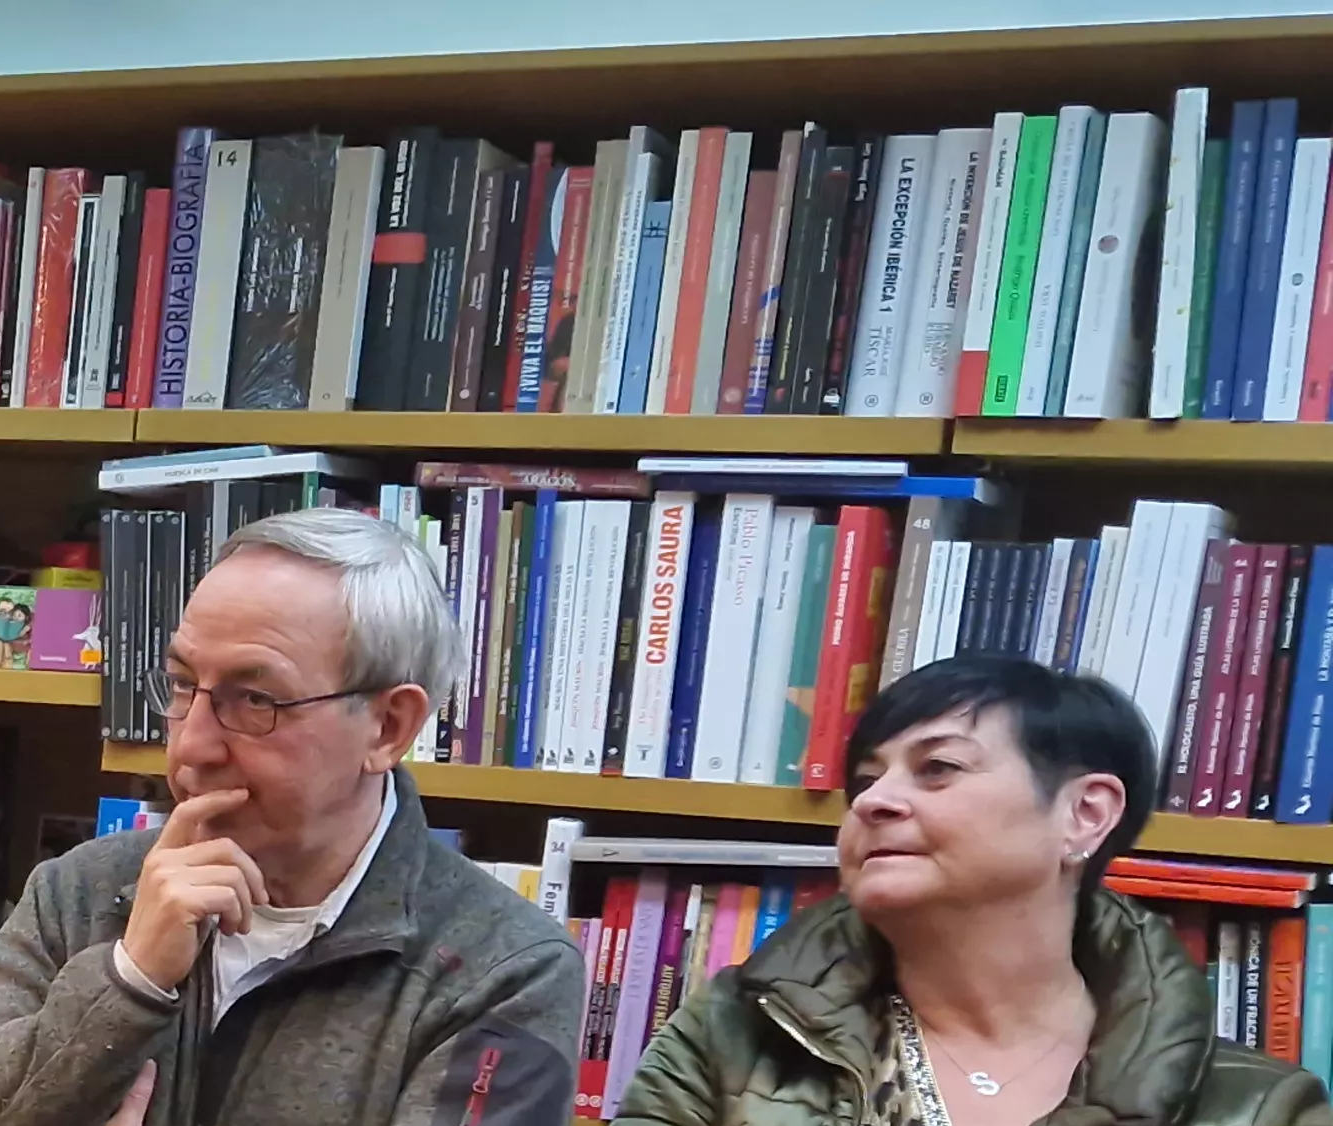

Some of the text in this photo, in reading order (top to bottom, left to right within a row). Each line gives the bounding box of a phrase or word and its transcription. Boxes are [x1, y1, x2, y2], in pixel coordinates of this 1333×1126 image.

[899, 157, 916, 175] LA
[887, 177, 914, 250] EXCEPCIÓN
[880, 252, 906, 302] IBÉRICA
[644, 505, 684, 666] CARLOS SAURA
[733, 554, 753, 606] Picasso
[550, 840, 566, 854] 34
